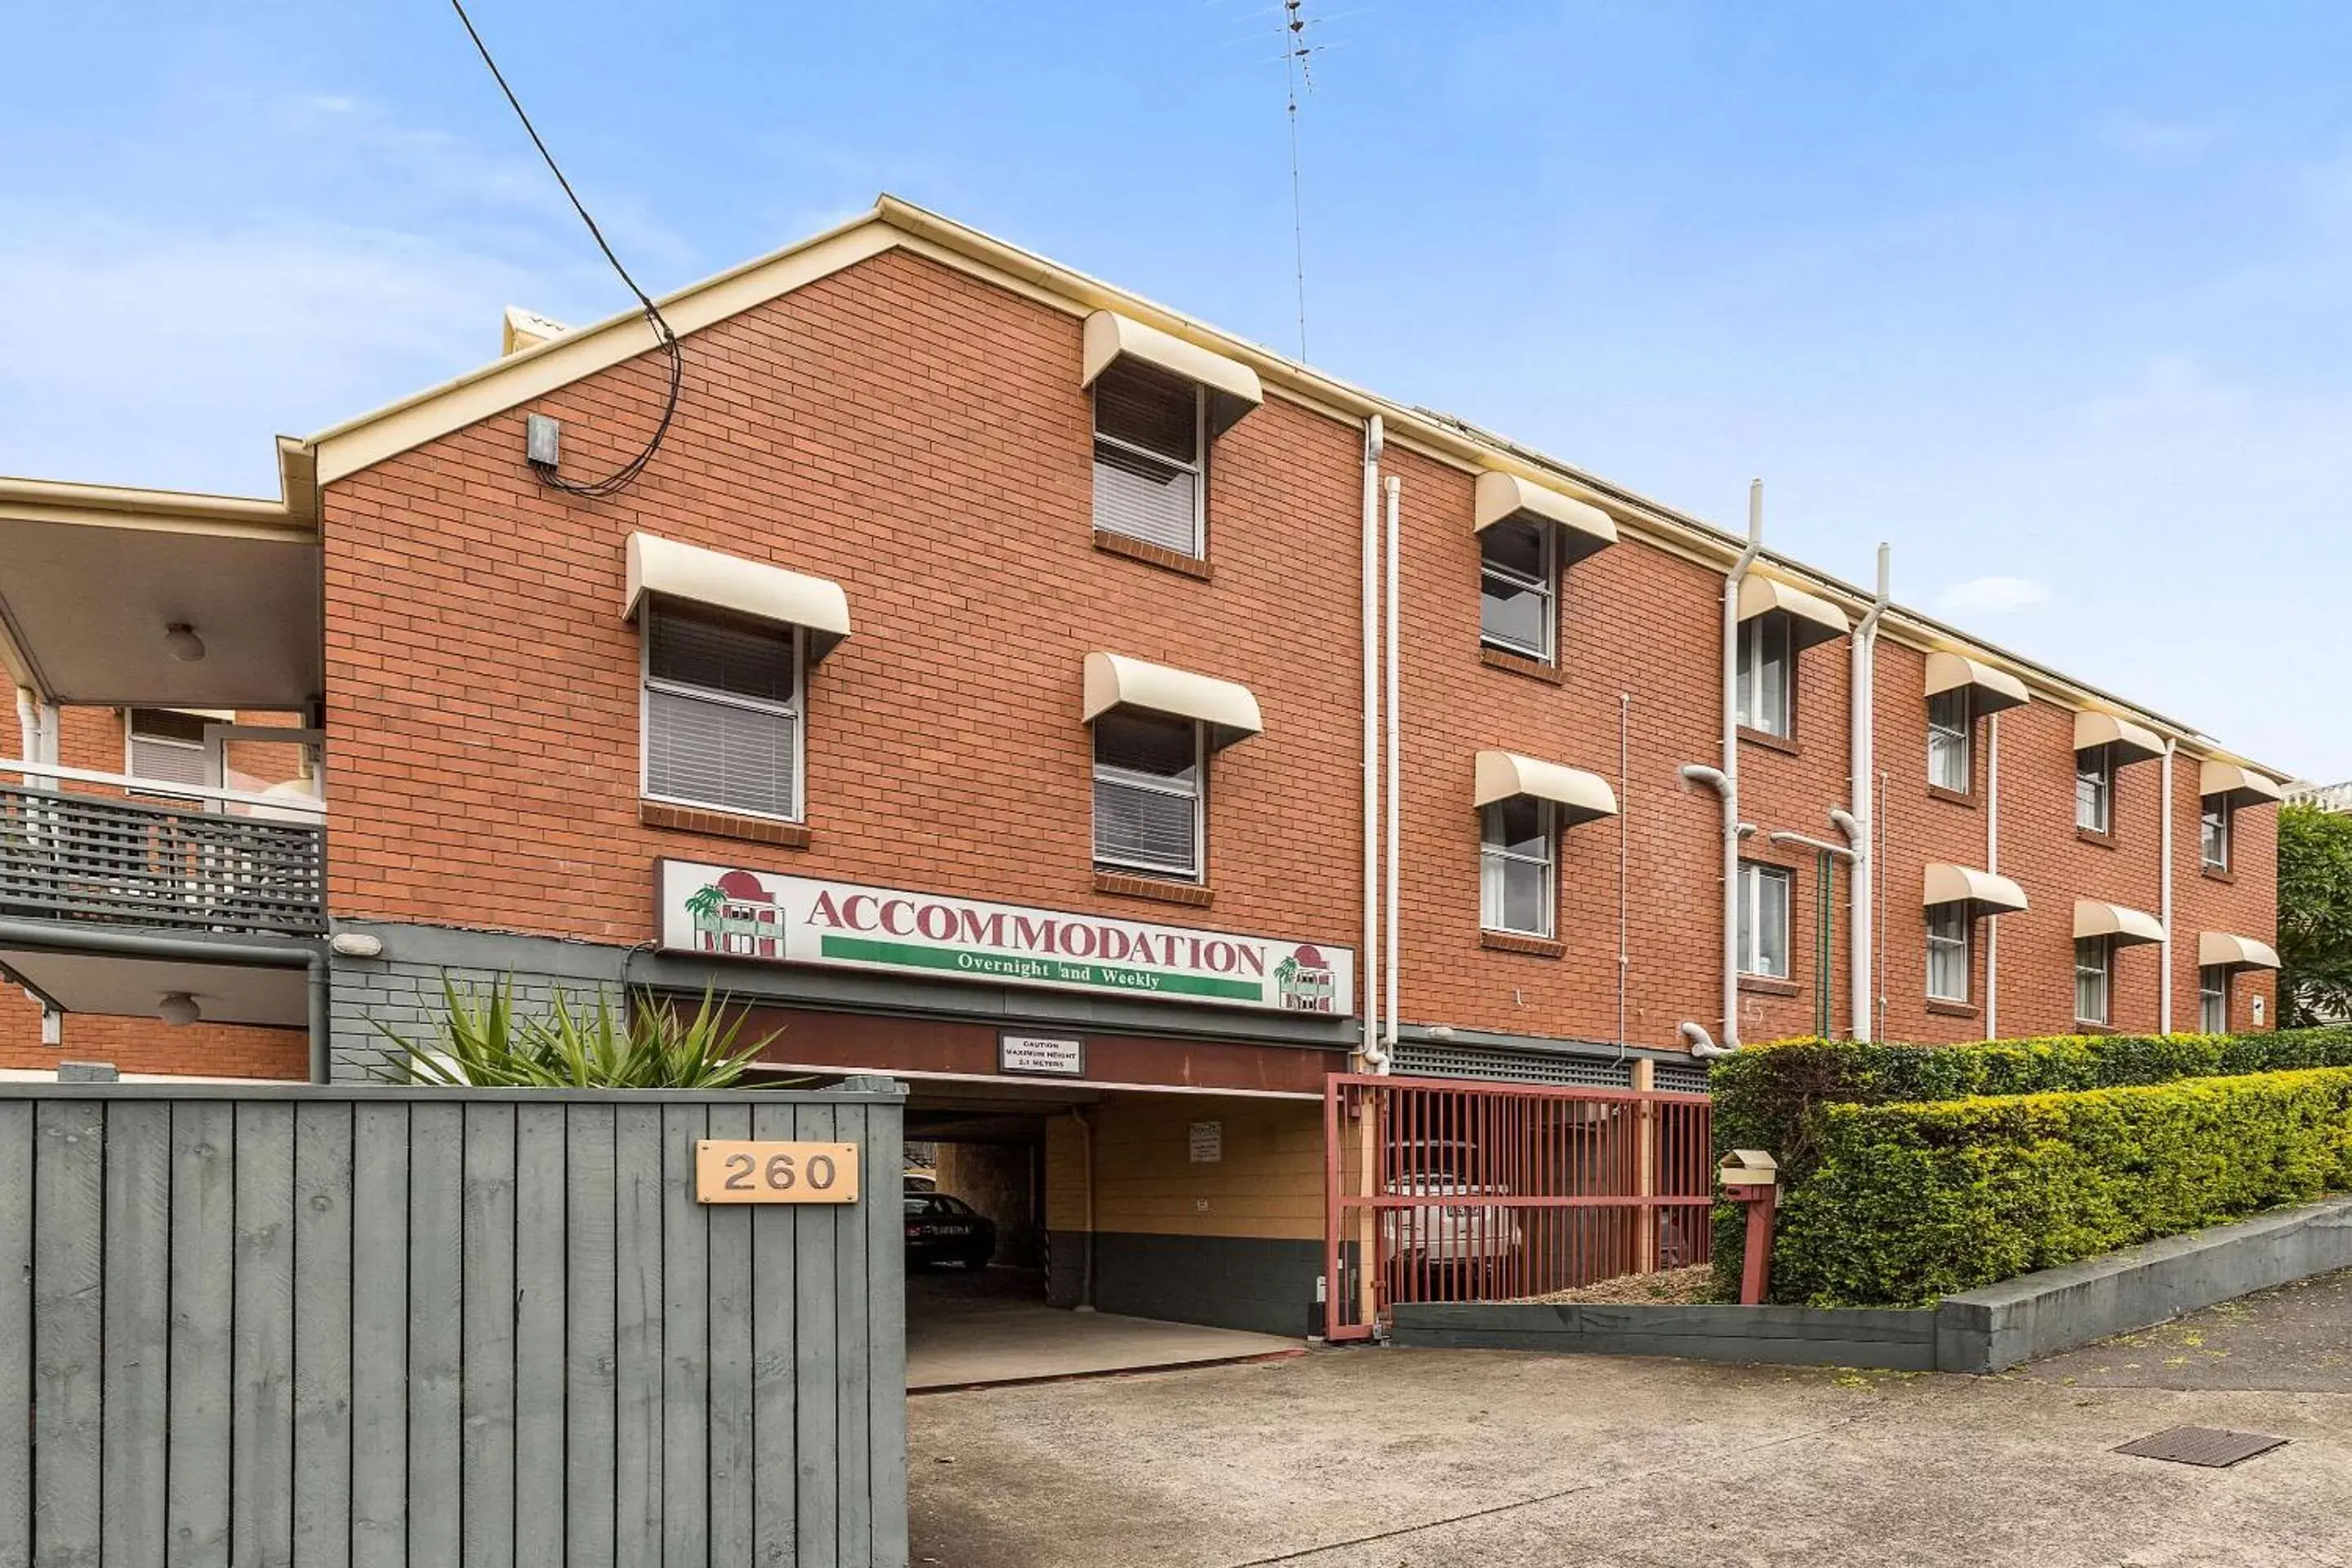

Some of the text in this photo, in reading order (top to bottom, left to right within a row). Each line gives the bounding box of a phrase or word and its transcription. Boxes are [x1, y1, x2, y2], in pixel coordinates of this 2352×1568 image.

[804, 889, 1267, 977] ACCOMMODATION
[957, 952, 1160, 990] Overnight and Weekly
[1006, 1049, 1045, 1058] MAXIMUM
[1023, 1040, 1059, 1049] CAUTION
[1033, 1059, 1064, 1068] METERS
[725, 1153, 836, 1190] 260
